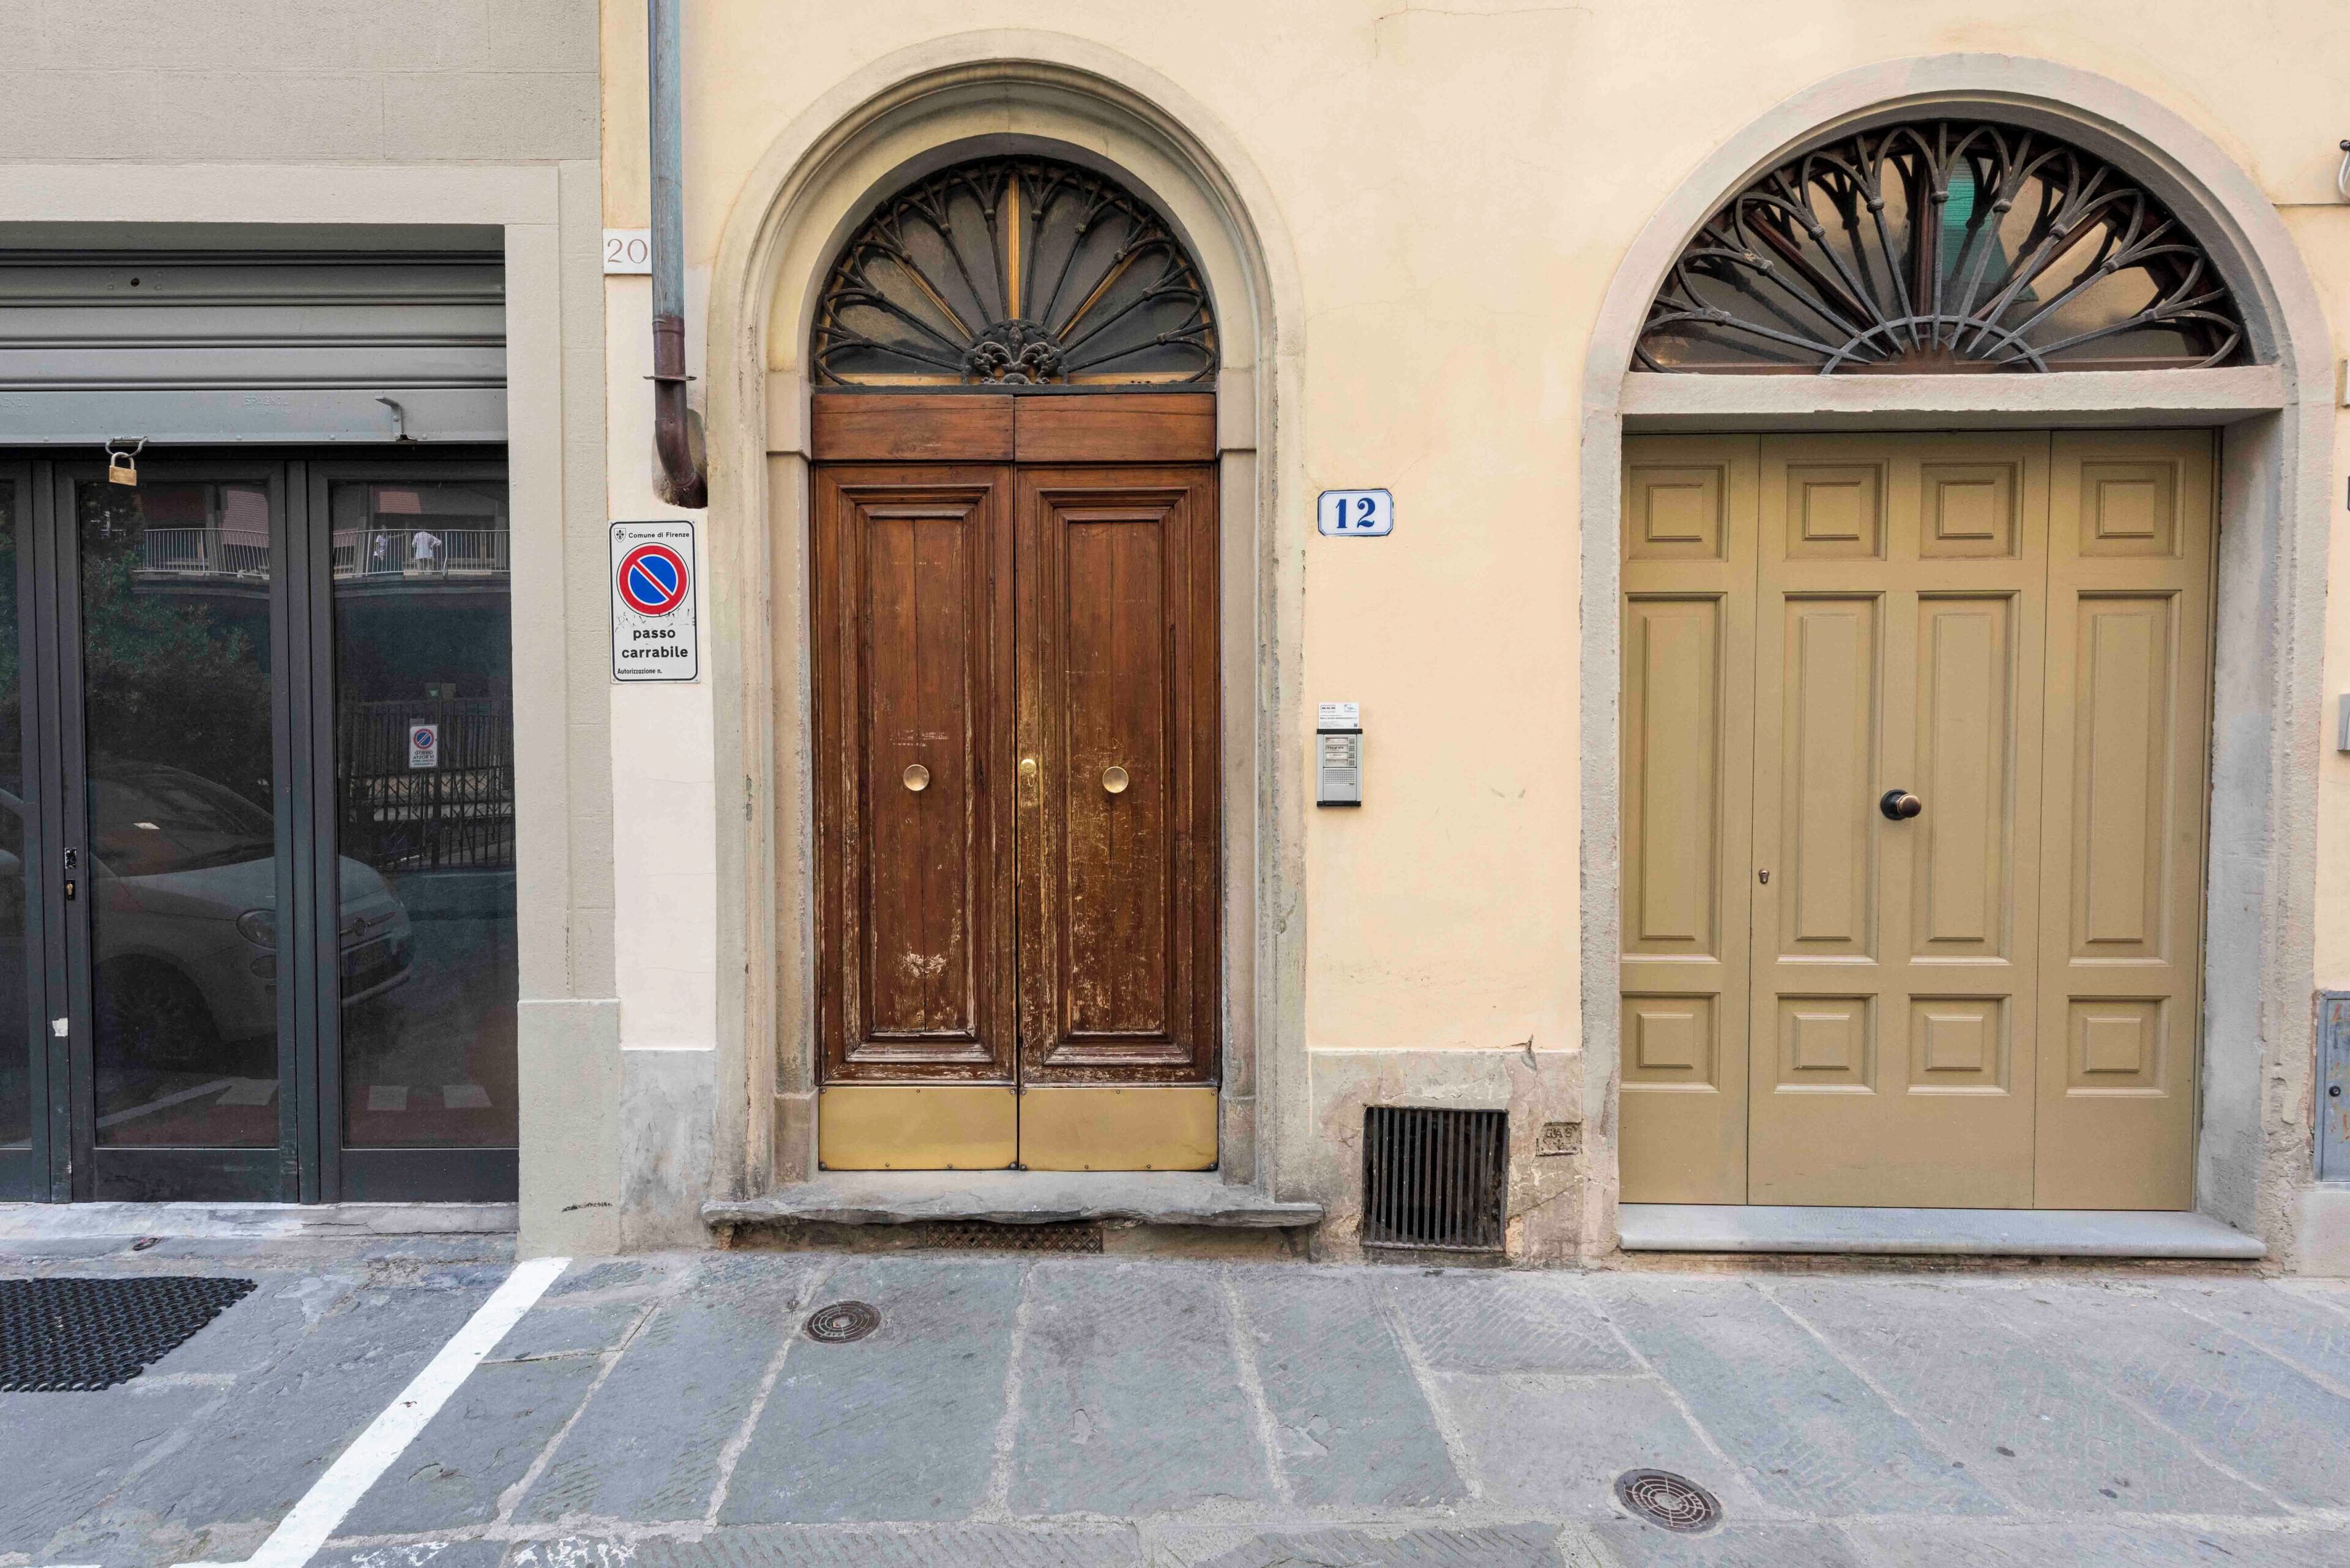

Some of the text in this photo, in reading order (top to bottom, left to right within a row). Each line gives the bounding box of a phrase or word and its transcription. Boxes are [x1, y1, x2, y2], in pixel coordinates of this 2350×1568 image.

[607, 239, 648, 264] 20
[1335, 497, 1376, 529] 12
[633, 629, 676, 641] passo
[622, 646, 688, 658] carrabile
